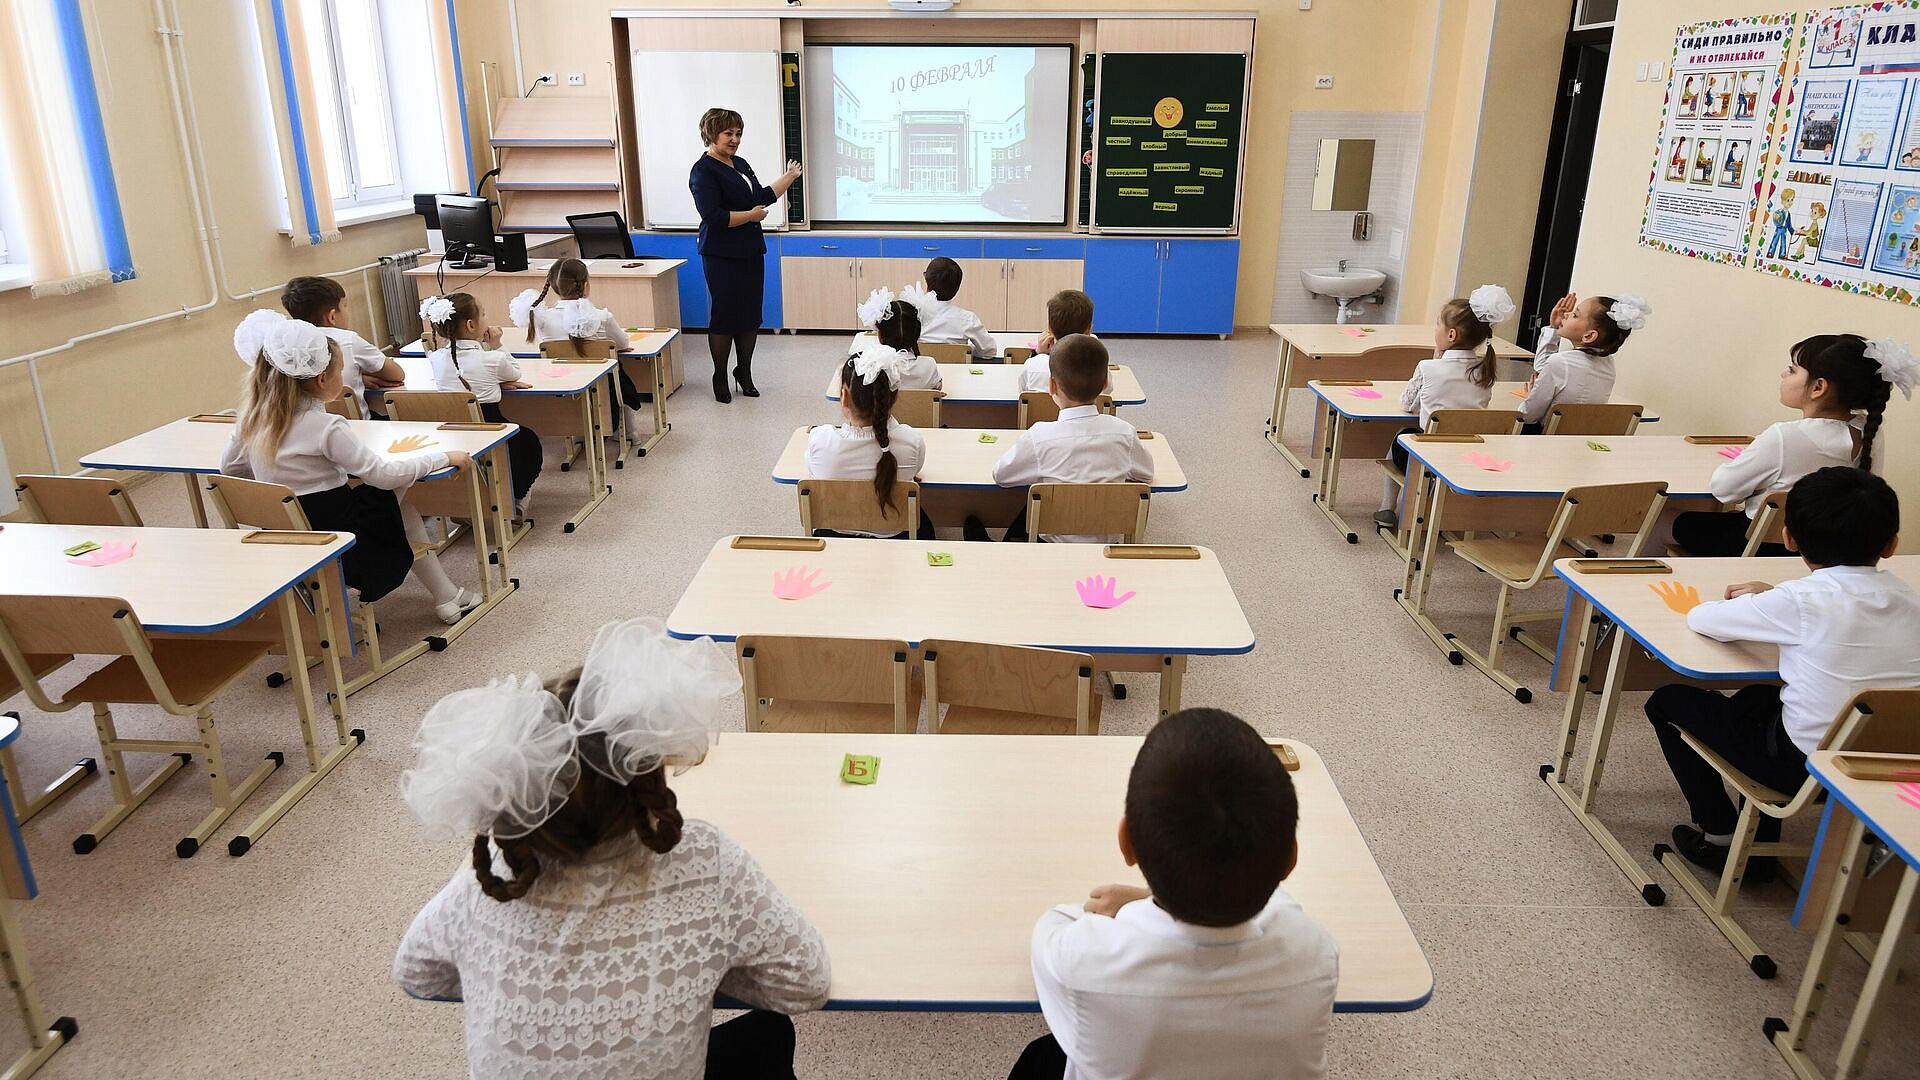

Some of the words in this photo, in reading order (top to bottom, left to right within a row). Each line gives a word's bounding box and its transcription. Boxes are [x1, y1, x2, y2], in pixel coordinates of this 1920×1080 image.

[1833, 18, 1843, 41] 1
[1866, 23, 1916, 46] КЛА
[1681, 37, 1710, 49] СИДИ
[1712, 30, 1782, 46] ПРАВИЛЬНО
[1825, 35, 1848, 52] КЛАСС
[1690, 55, 1695, 64] И
[1697, 54, 1706, 63] НЕ
[1708, 50, 1765, 62] ОТВЛЕКАЙСЯ
[890, 76, 905, 93] 10
[910, 55, 997, 91] ФЕВРАЛЯ
[1165, 130, 1187, 138] добрый
[848, 759, 867, 776] Б
